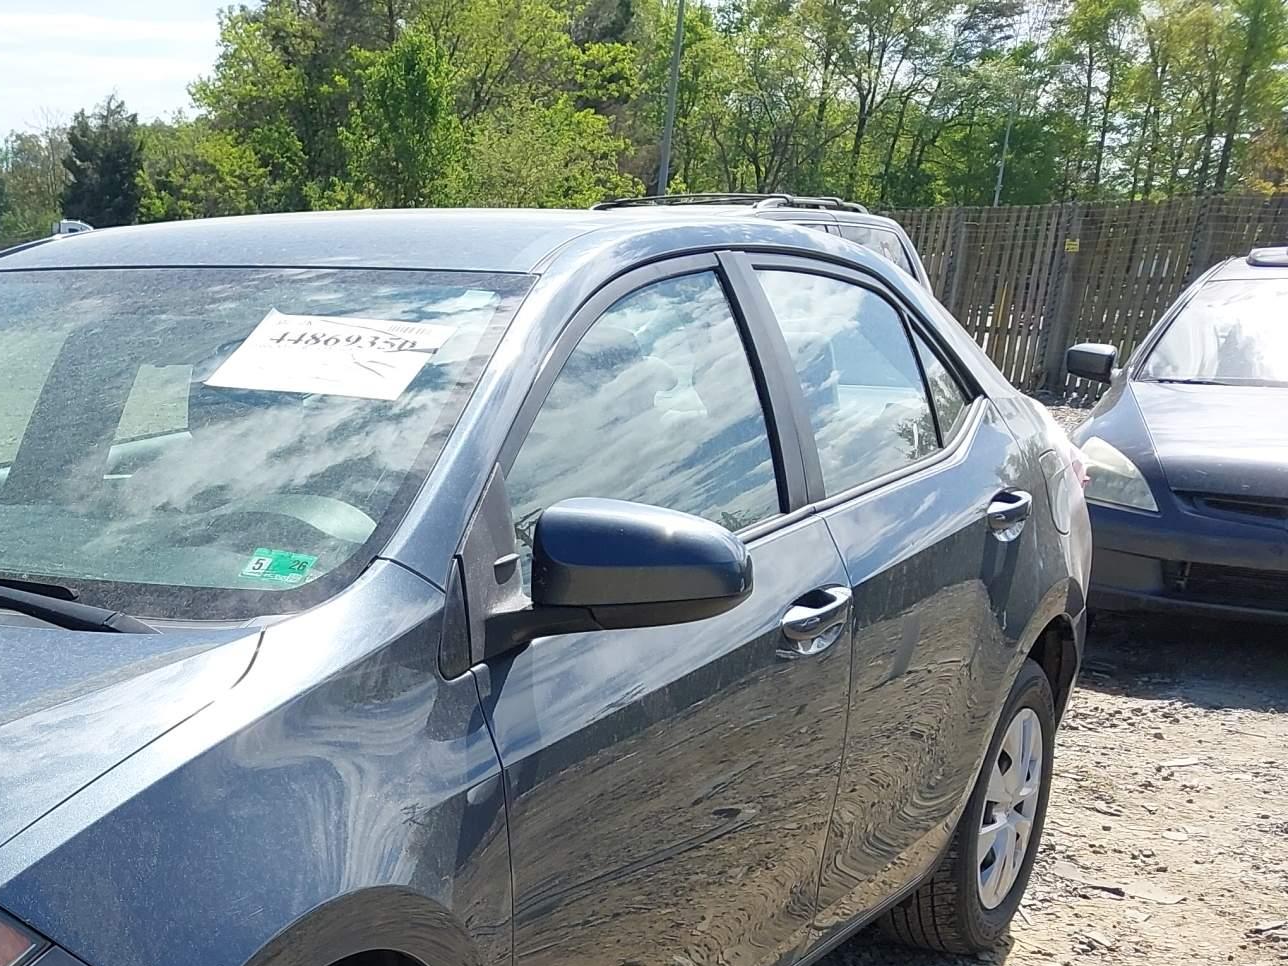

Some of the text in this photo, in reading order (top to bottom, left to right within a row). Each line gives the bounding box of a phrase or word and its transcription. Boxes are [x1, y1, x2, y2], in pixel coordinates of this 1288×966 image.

[269, 331, 418, 352] 44869350
[252, 558, 309, 571] 5 26
